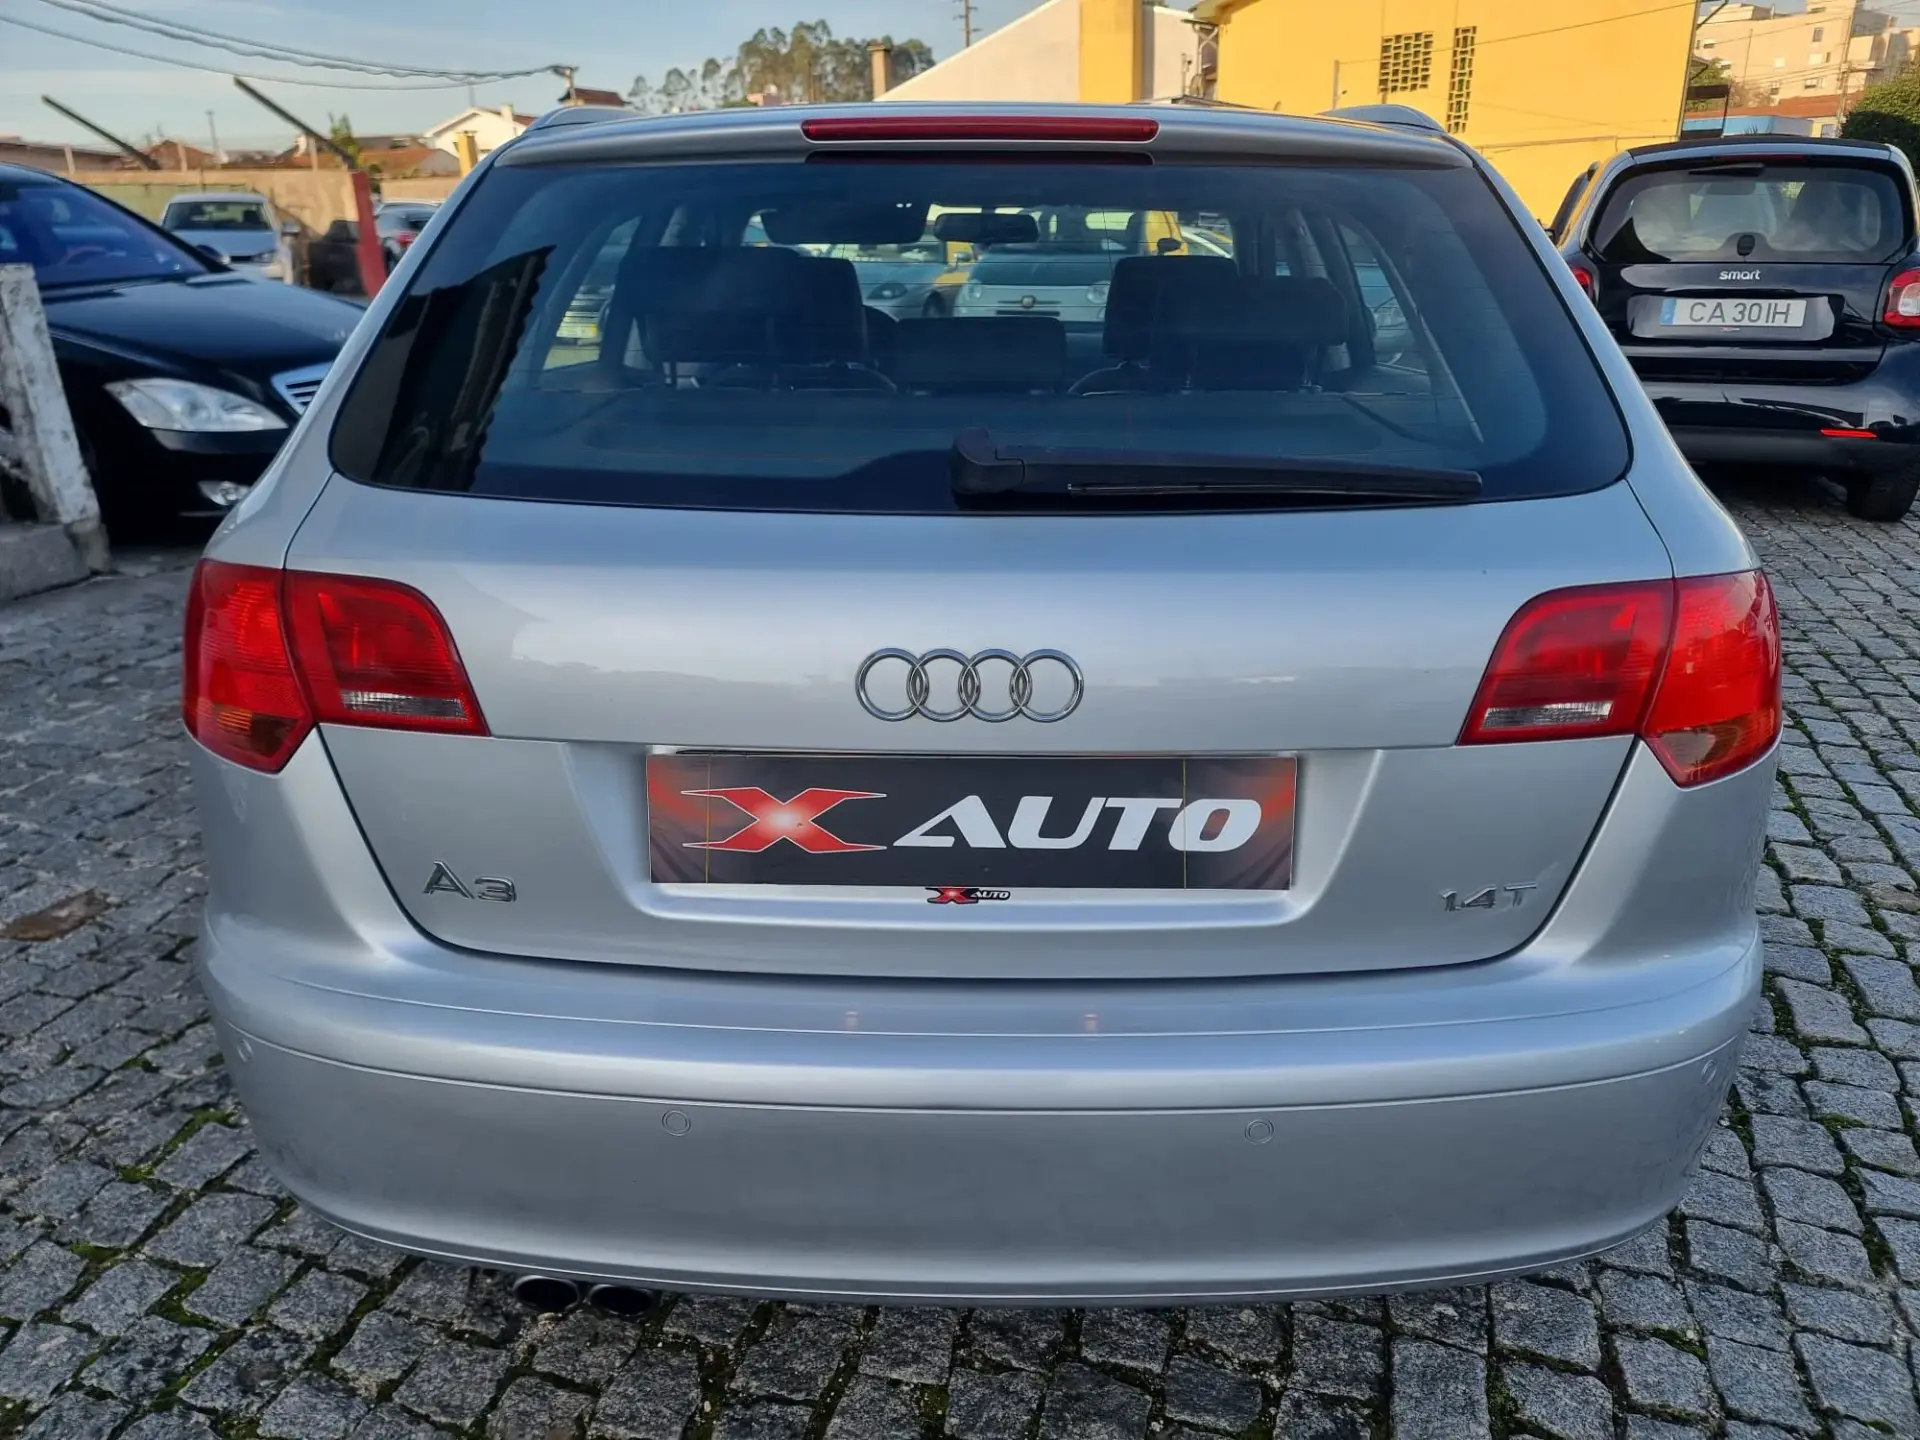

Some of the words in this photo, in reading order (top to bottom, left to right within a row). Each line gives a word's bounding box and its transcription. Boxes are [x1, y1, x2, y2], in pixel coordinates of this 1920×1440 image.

[1718, 269, 1761, 280] smart
[681, 786, 888, 854] X
[892, 794, 1262, 853] AUTO
[423, 860, 516, 903] A3
[970, 890, 1010, 899] AUTO
